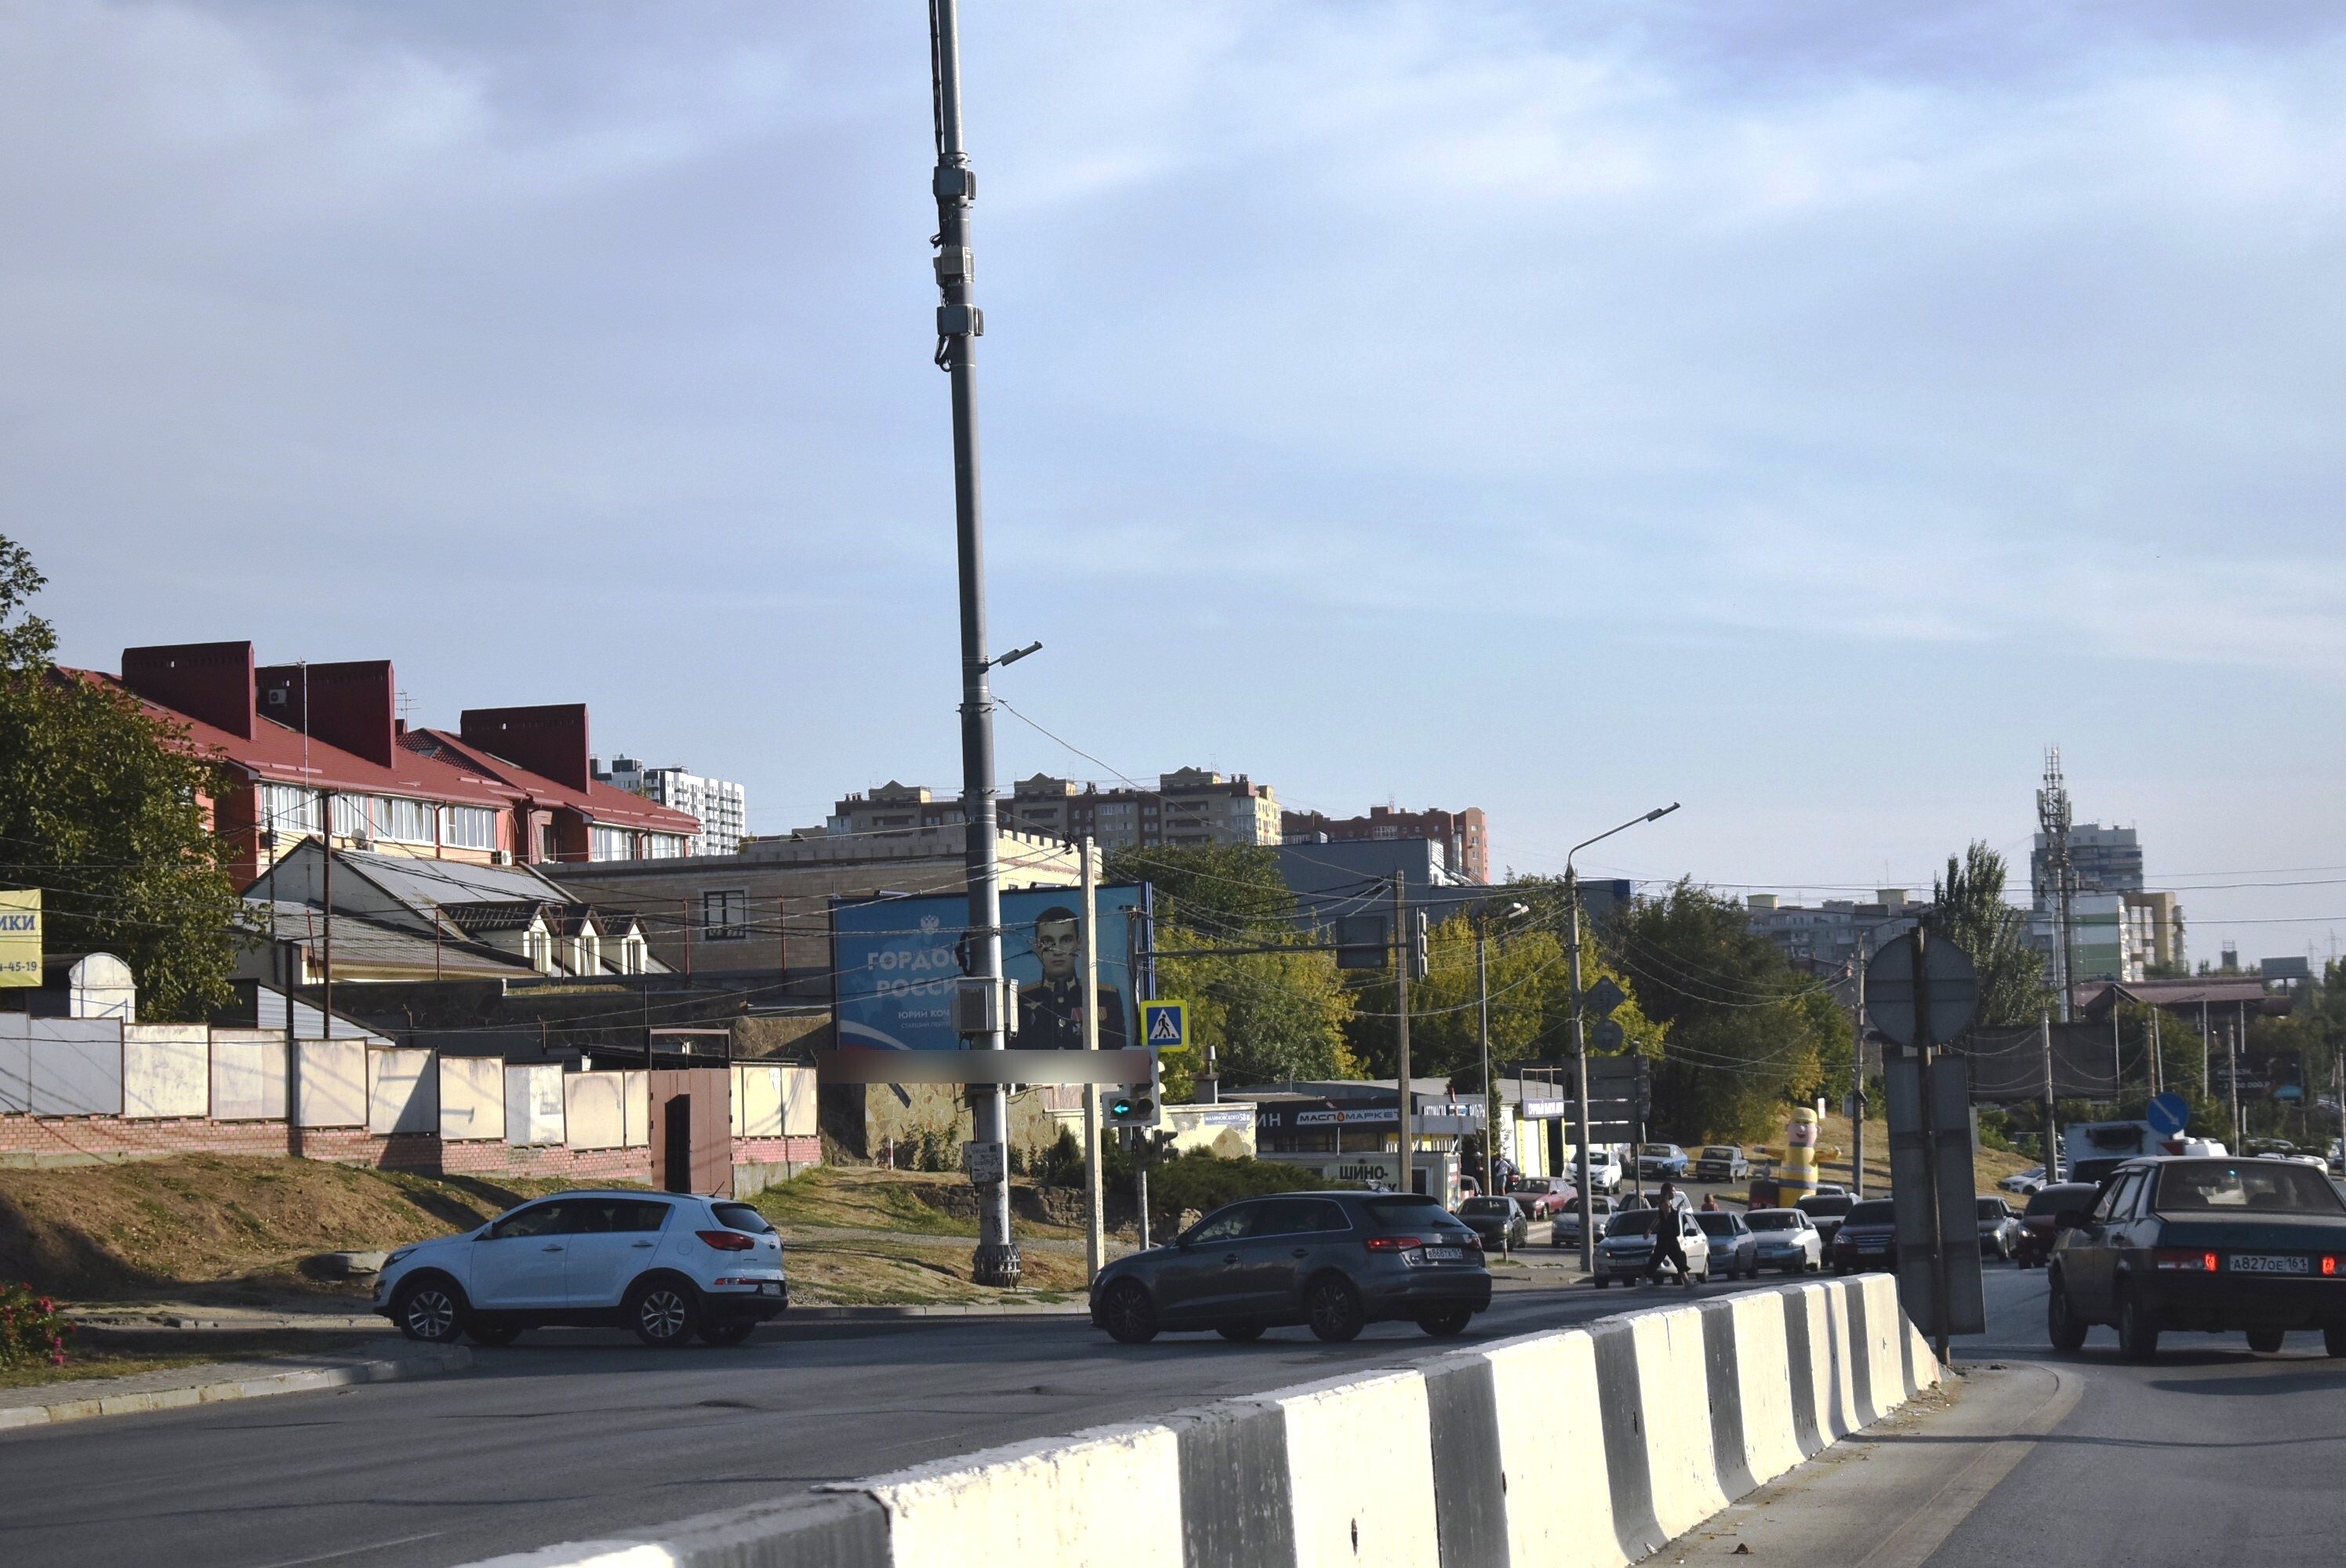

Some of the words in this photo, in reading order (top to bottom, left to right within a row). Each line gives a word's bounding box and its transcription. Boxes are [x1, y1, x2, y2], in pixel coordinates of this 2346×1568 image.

[898, 1009, 928, 1019] ЮРИЙ
[1340, 1165, 1388, 1180] ШИНО-
[2286, 1258, 2305, 1268] 161
